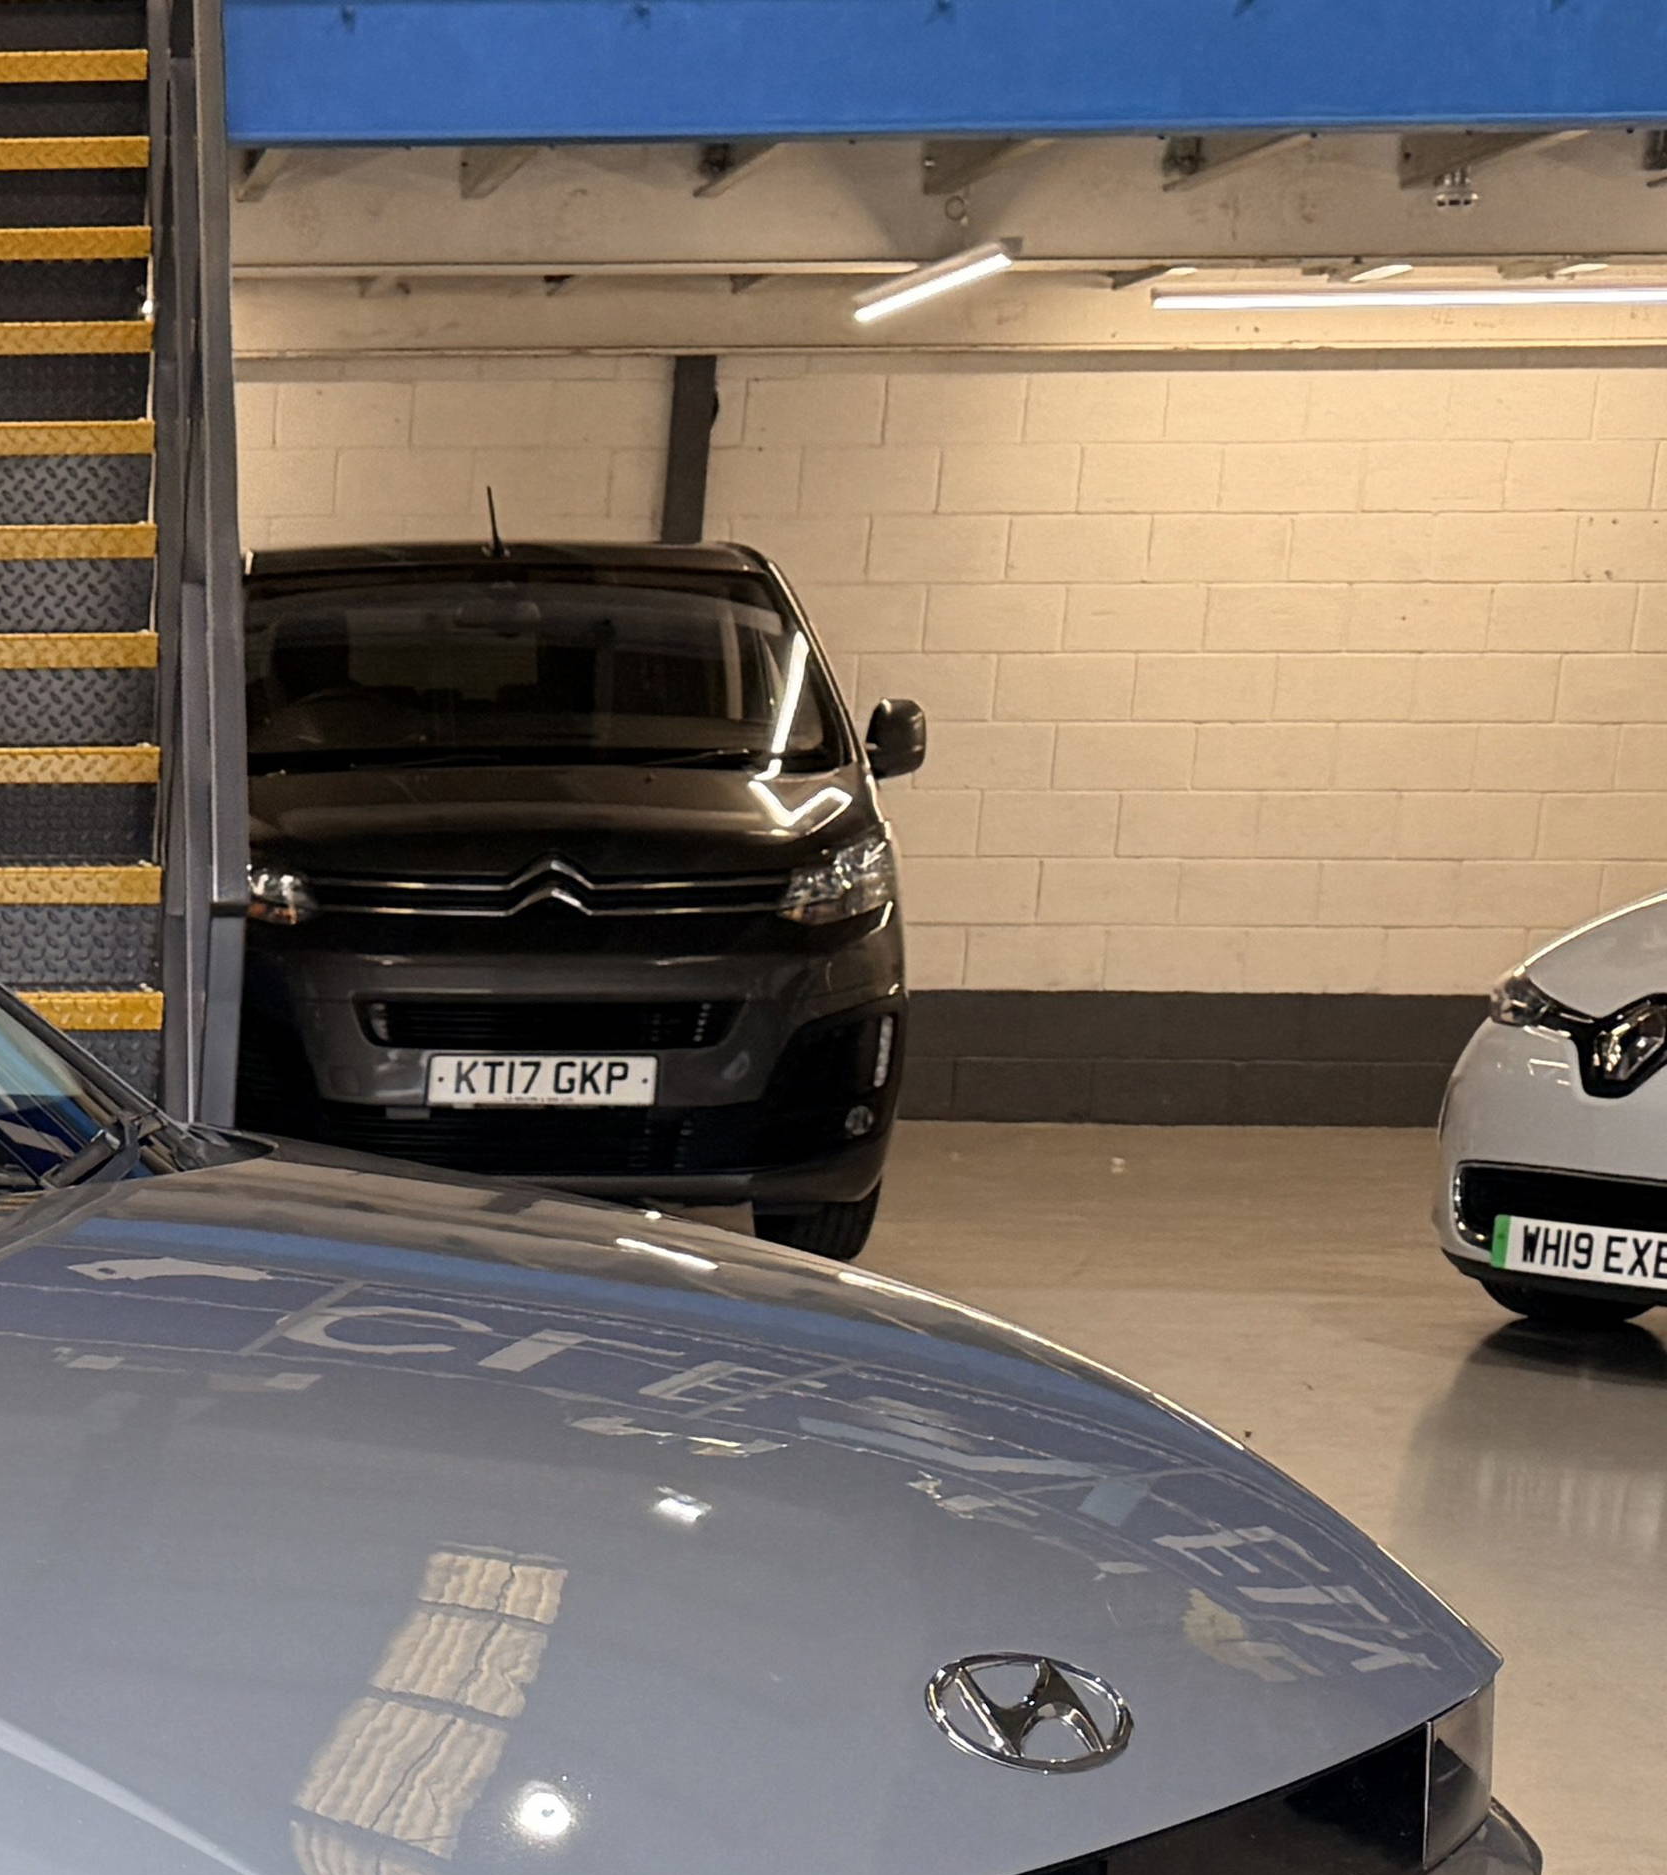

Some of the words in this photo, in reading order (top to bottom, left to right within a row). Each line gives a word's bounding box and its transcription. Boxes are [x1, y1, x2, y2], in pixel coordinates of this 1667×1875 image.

[454, 1060, 542, 1094] KT17
[553, 1061, 629, 1095] GKP
[1522, 1224, 1594, 1270] WH19
